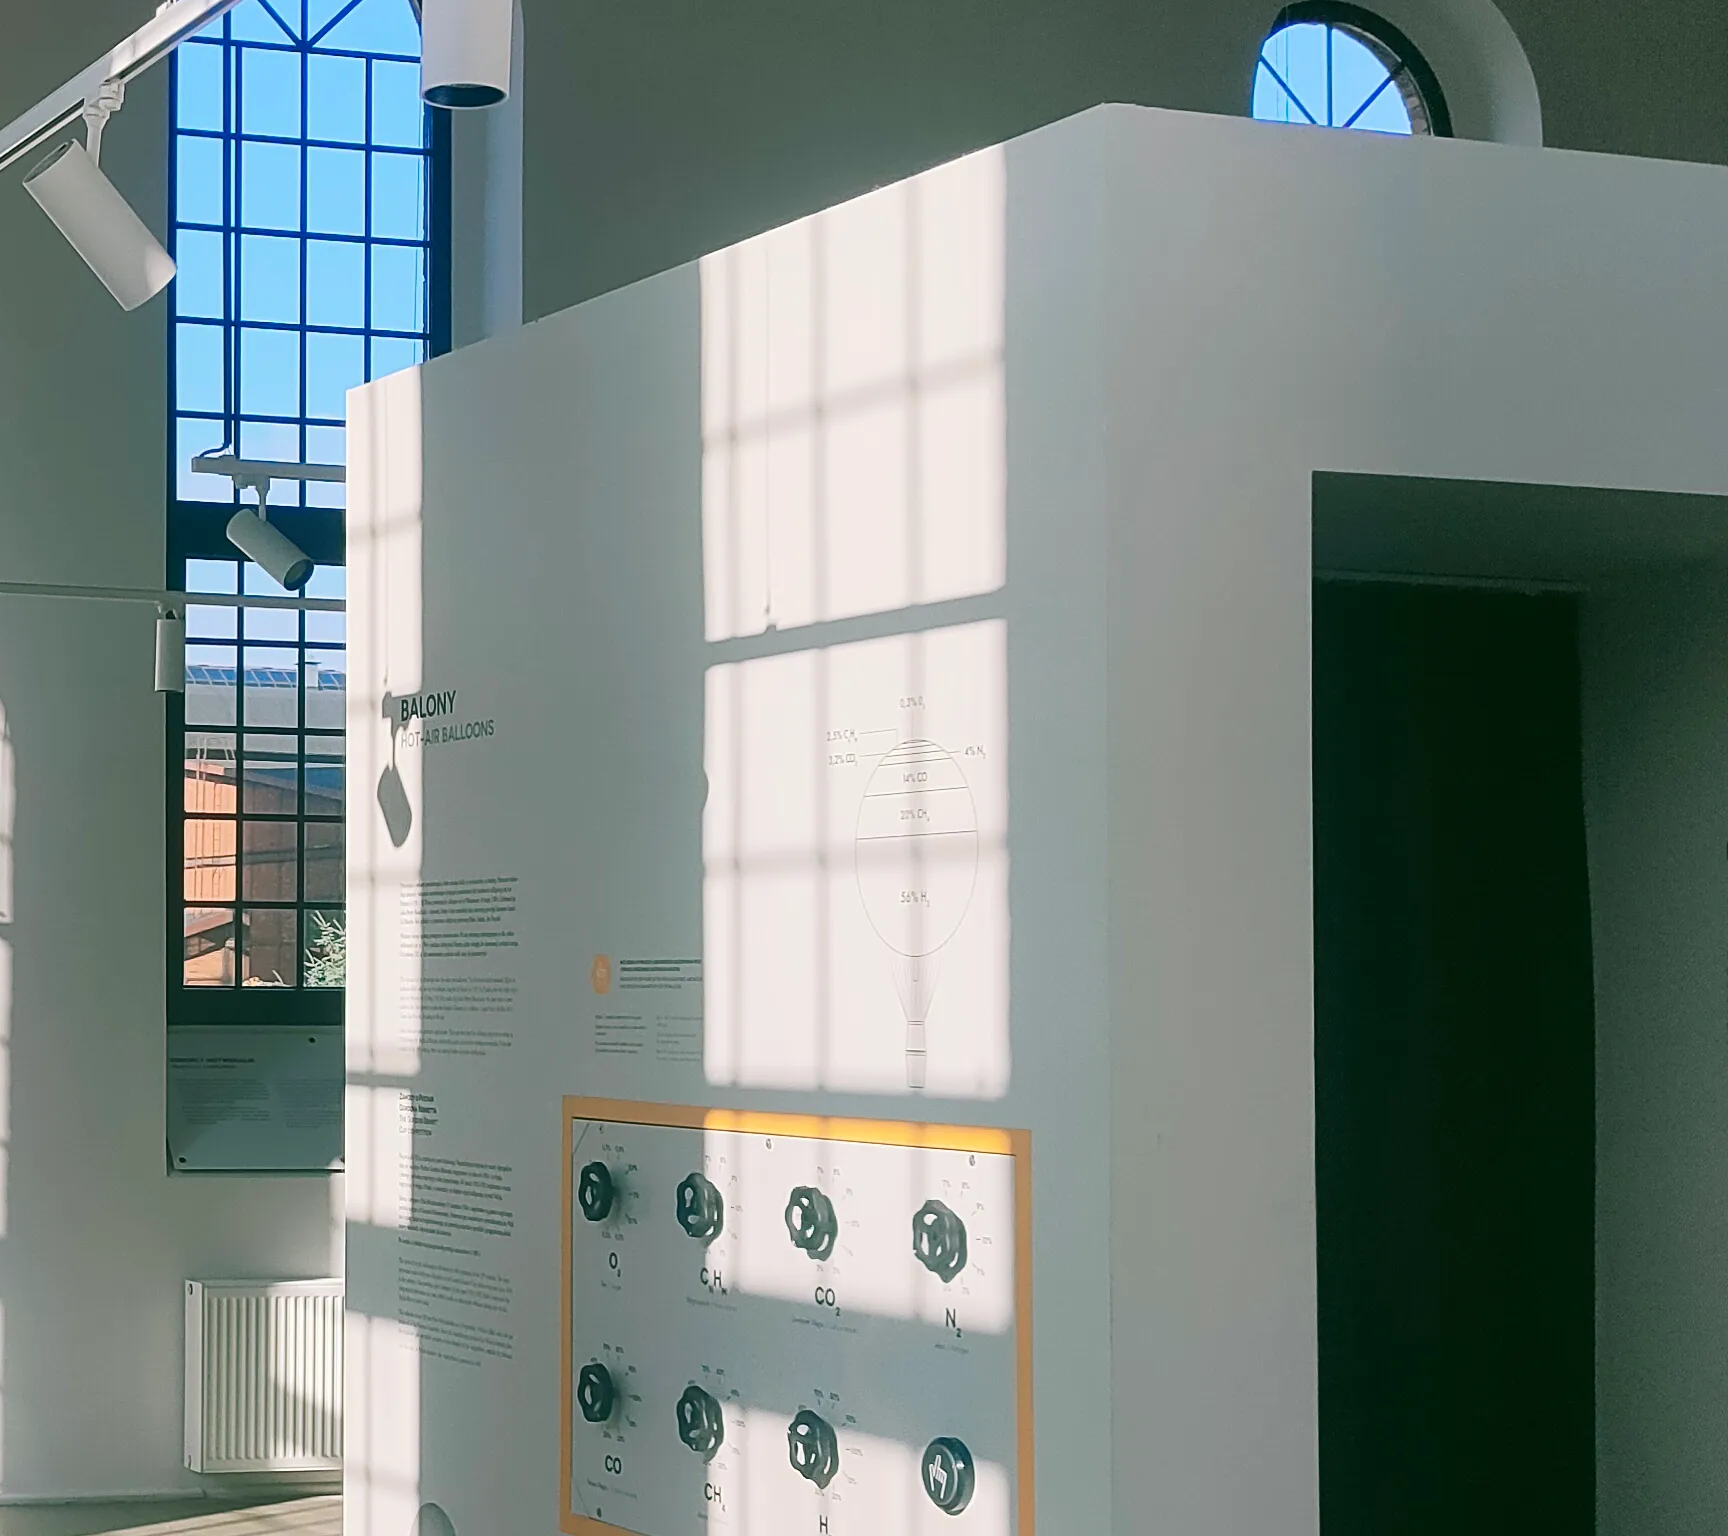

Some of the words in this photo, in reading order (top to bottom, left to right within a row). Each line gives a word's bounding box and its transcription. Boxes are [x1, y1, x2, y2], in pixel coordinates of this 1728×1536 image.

[401, 690, 457, 722] BALONY
[401, 728, 440, 749] HOT-AIR
[442, 719, 495, 743] BALLOONS
[815, 1286, 841, 1317] CO2
[945, 1307, 962, 1338] N2
[605, 1454, 622, 1475] CO
[704, 1482, 727, 1513] CH4
